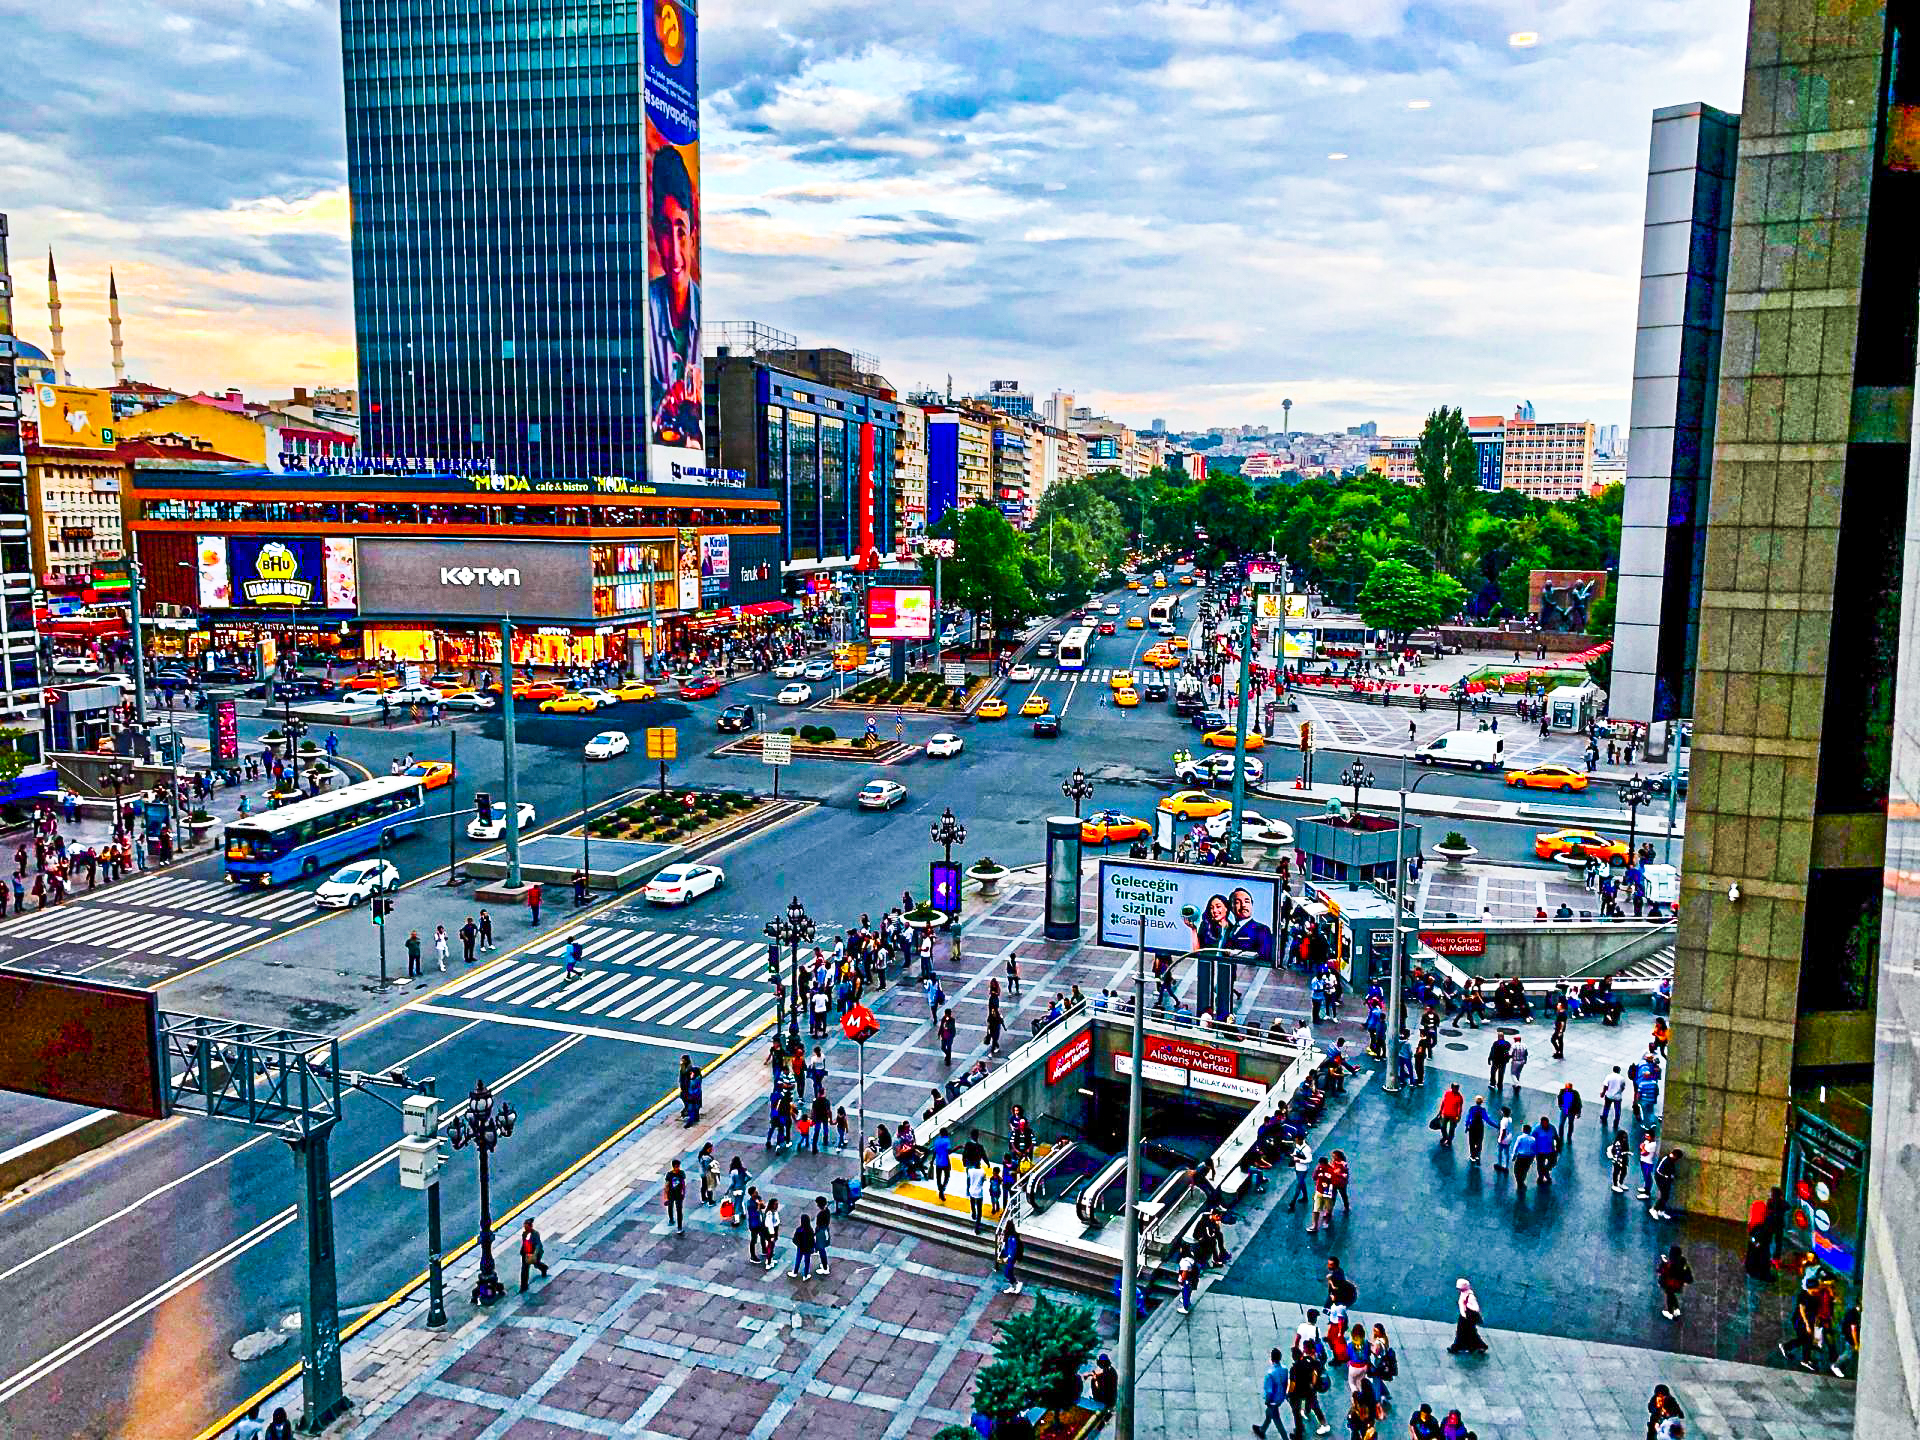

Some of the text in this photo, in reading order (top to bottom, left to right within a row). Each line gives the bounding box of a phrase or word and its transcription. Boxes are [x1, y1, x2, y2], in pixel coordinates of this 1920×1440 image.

[473, 474, 531, 491] MODA
[563, 481, 589, 491] bistro
[596, 475, 629, 493] MODA
[262, 556, 290, 572] BHU
[248, 582, 308, 597] HASAN USTA
[1111, 874, 1179, 892] Geleceğin
[1115, 889, 1174, 905] fırsatları
[1122, 902, 1166, 917] sizinle
[1150, 919, 1178, 930] BBVA
[1448, 943, 1482, 952] Merkezi
[846, 1013, 861, 1028] M
[1150, 1049, 1190, 1066] Alışveriş
[1191, 1058, 1233, 1074] Merkezi
[1175, 1045, 1231, 1064] Metro Çarşısı
[1193, 1077, 1221, 1088] KIZILAY
[1221, 1081, 1238, 1091] AVM
